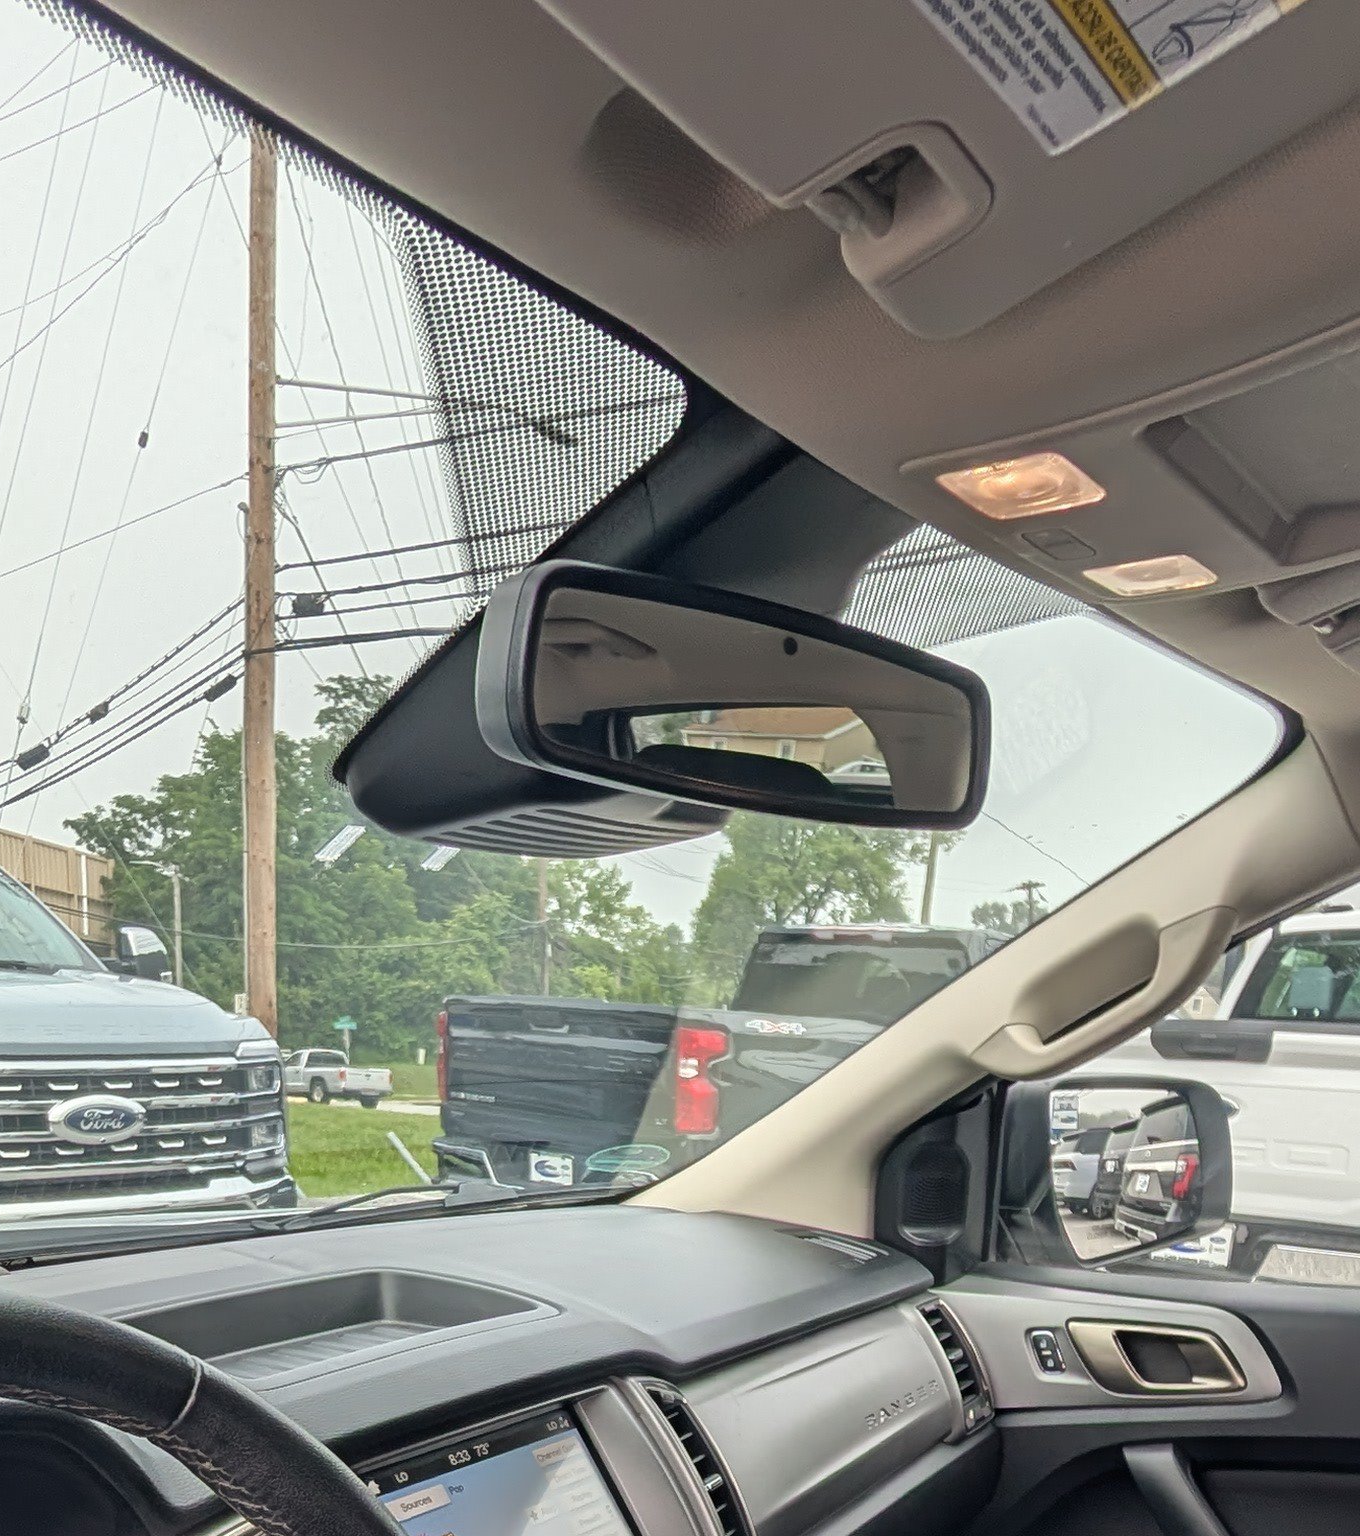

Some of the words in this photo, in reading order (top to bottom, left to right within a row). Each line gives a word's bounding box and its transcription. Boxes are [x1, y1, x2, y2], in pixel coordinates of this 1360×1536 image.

[81, 1109, 125, 1130] Ford
[865, 1379, 940, 1430] RANGER
[448, 1484, 464, 1496] Pop
[400, 1495, 433, 1513] Sources
